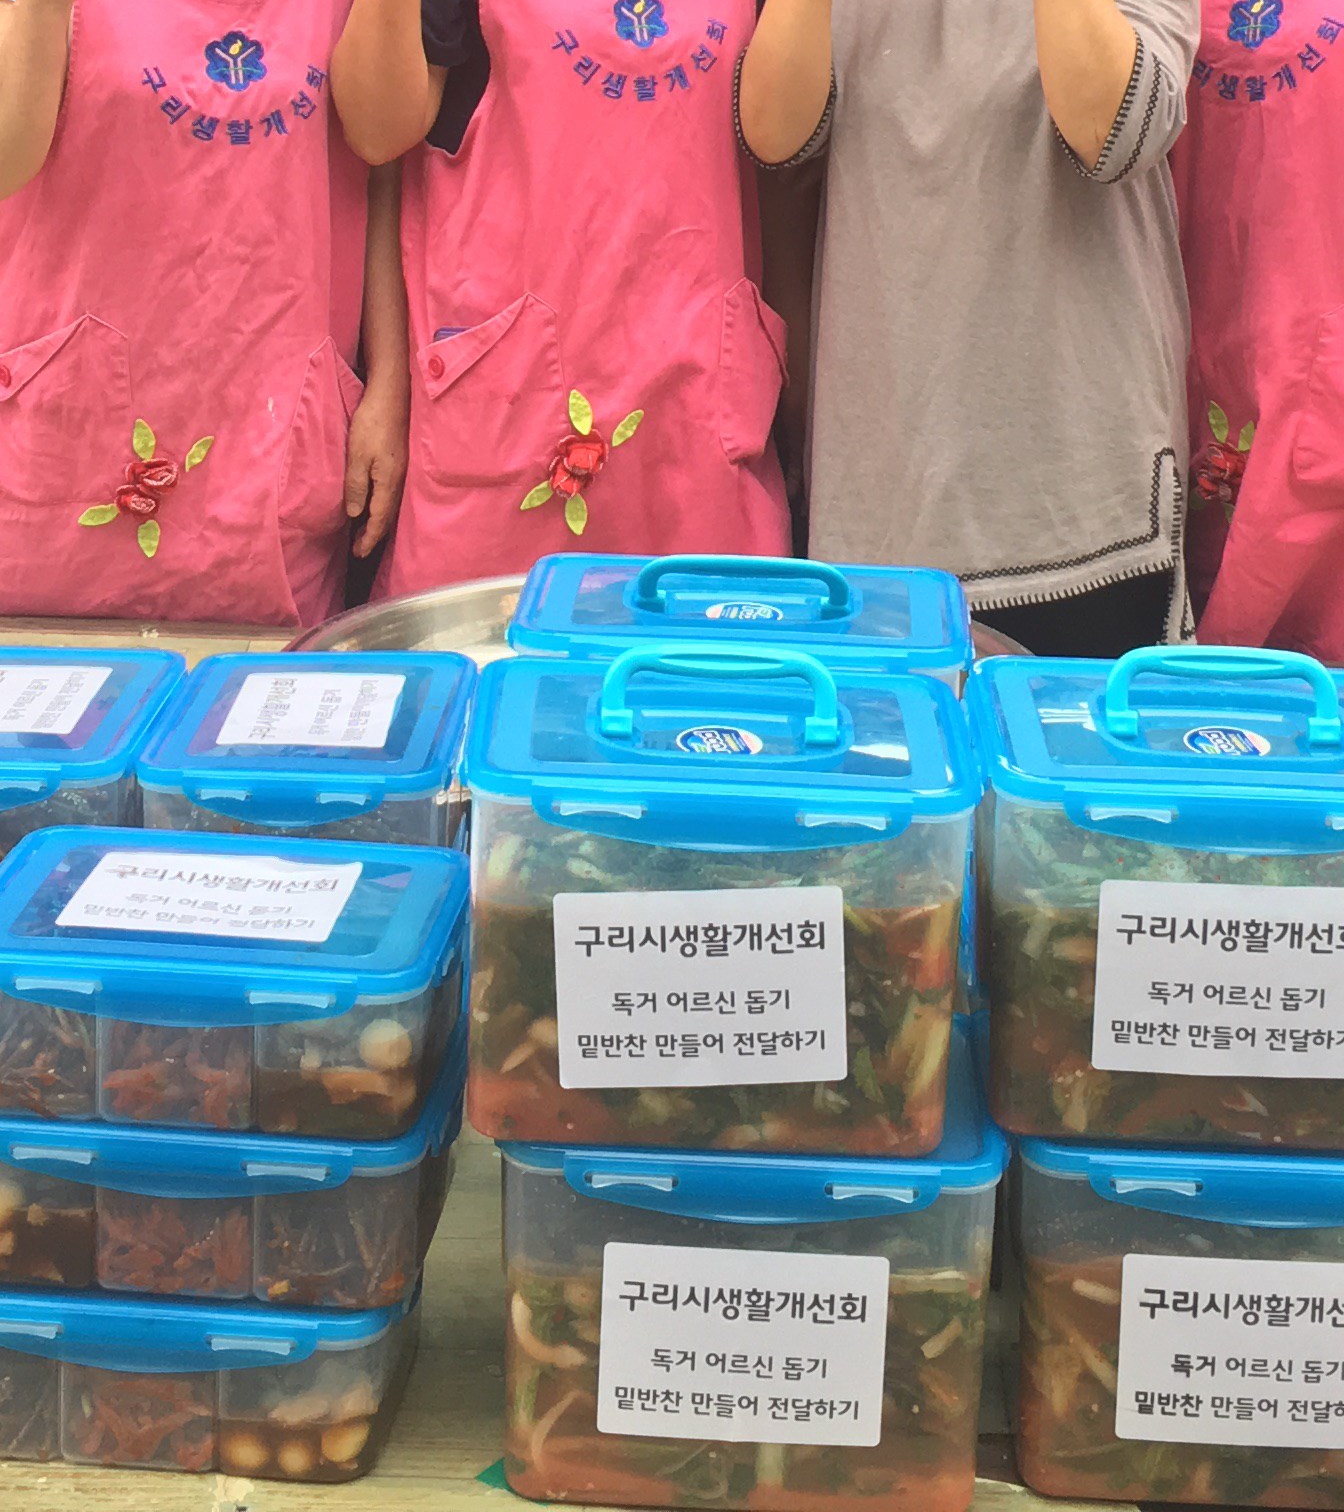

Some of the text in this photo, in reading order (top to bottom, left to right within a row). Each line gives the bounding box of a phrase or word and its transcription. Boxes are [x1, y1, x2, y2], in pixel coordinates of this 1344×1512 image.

[552, 18, 728, 102] 구리생활개선회
[142, 64, 327, 145] 구리생활개선회
[106, 865, 339, 892] 구리시생활개선회
[575, 920, 824, 957] 구리시생활개선회
[613, 990, 789, 1016] 독거 어르신 돕기
[1149, 982, 1324, 1011] 독거 어르신 돕기
[578, 1030, 824, 1058] 밑반찬 만들어 전달하기
[1112, 1021, 1179, 1045] 밑반찬
[1189, 1025, 1255, 1049] 만들어
[620, 1281, 866, 1324] 구리시생활개선회
[652, 1349, 826, 1380] 독거 어르신 돕기
[1171, 1354, 1344, 1383] 독거 어르신 돕기
[615, 1387, 858, 1421] 밑반찬 만들어 전달하기
[1135, 1391, 1203, 1417] 밑반찬
[1211, 1397, 1278, 1420] 만들어
